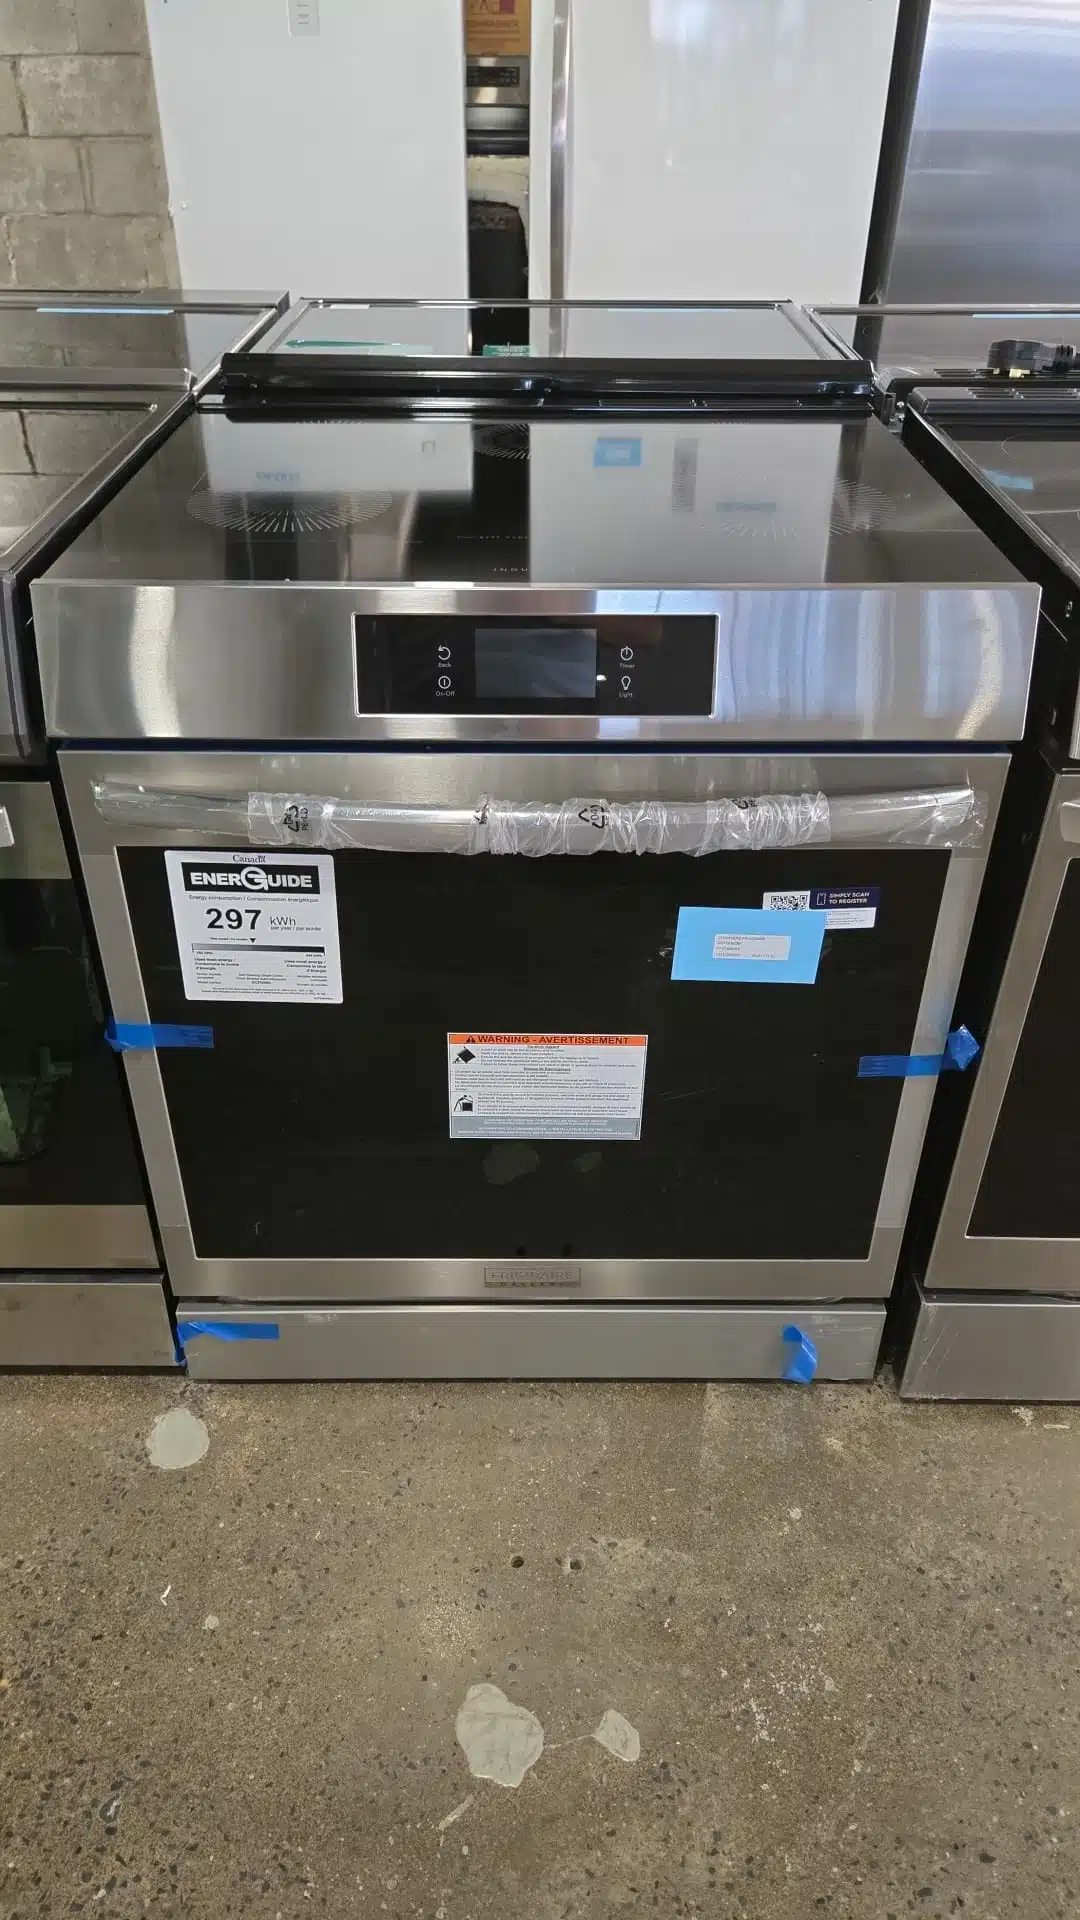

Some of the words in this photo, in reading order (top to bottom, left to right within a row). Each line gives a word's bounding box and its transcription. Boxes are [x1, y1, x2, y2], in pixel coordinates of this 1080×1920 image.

[232, 854, 266, 863] Canada
[190, 867, 312, 891] ENERGUIDE
[206, 908, 262, 930] 297
[270, 916, 296, 926] kWh
[478, 1036, 530, 1044] WARNING
[539, 1036, 630, 1045] AVERTISSEMENT
